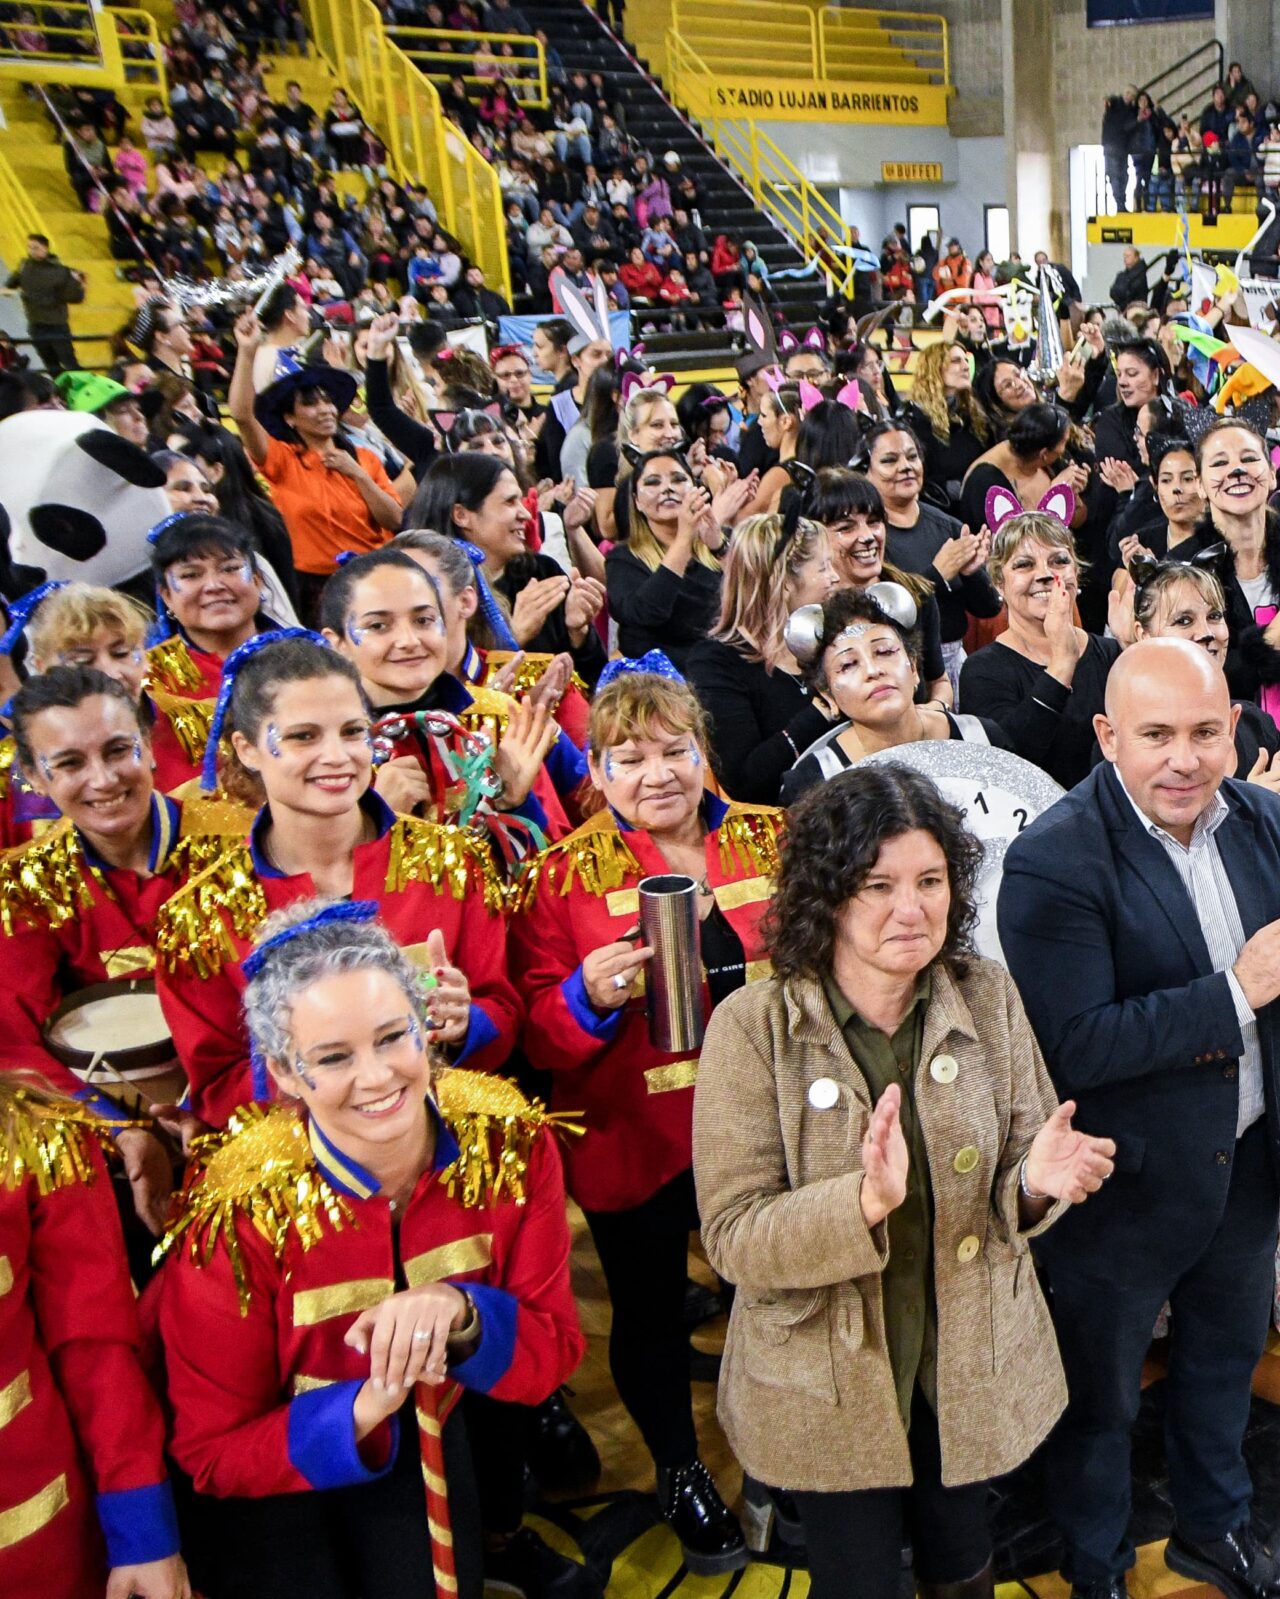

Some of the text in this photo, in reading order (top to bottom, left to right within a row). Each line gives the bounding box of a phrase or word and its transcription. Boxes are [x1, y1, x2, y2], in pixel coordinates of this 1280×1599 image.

[709, 87, 920, 113] STADIO LUJAN BARRIENTOS
[896, 163, 938, 179] BUFFET
[974, 791, 989, 815] 1
[1012, 808, 1031, 833] 2
